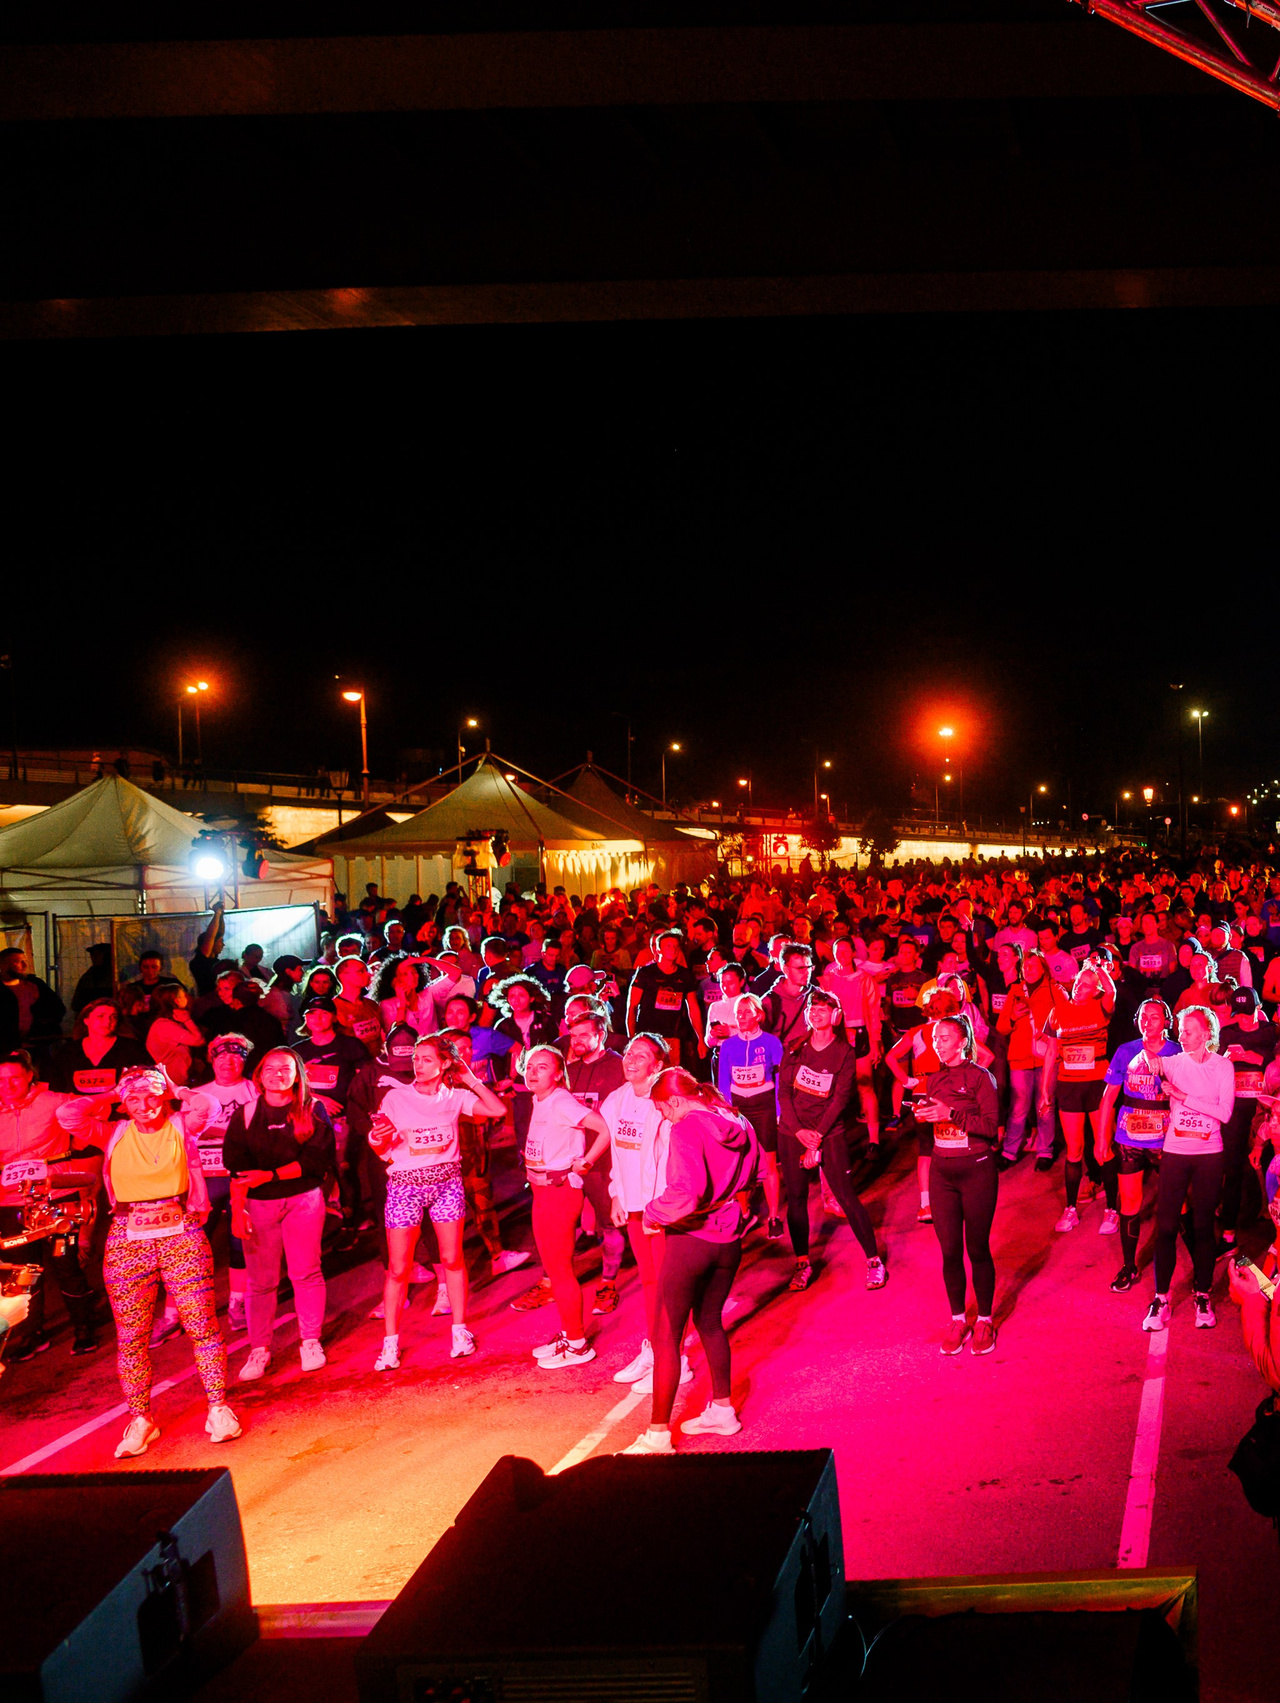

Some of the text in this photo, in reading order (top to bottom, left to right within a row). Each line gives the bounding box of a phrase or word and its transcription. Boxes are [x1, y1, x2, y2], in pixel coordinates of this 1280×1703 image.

[736, 1073, 757, 1081] 2752
[800, 1075, 821, 1087] 2911
[1131, 1122, 1154, 1131] 5682
[1179, 1118, 1203, 1128] 2951
[617, 1126, 637, 1137] 2688
[415, 1133, 444, 1145] 2313
[201, 1156, 221, 1165] 218
[5, 1167, 36, 1181] 2378
[134, 1212, 171, 1226] 6146
[3, 1236, 28, 1248] RONIN
